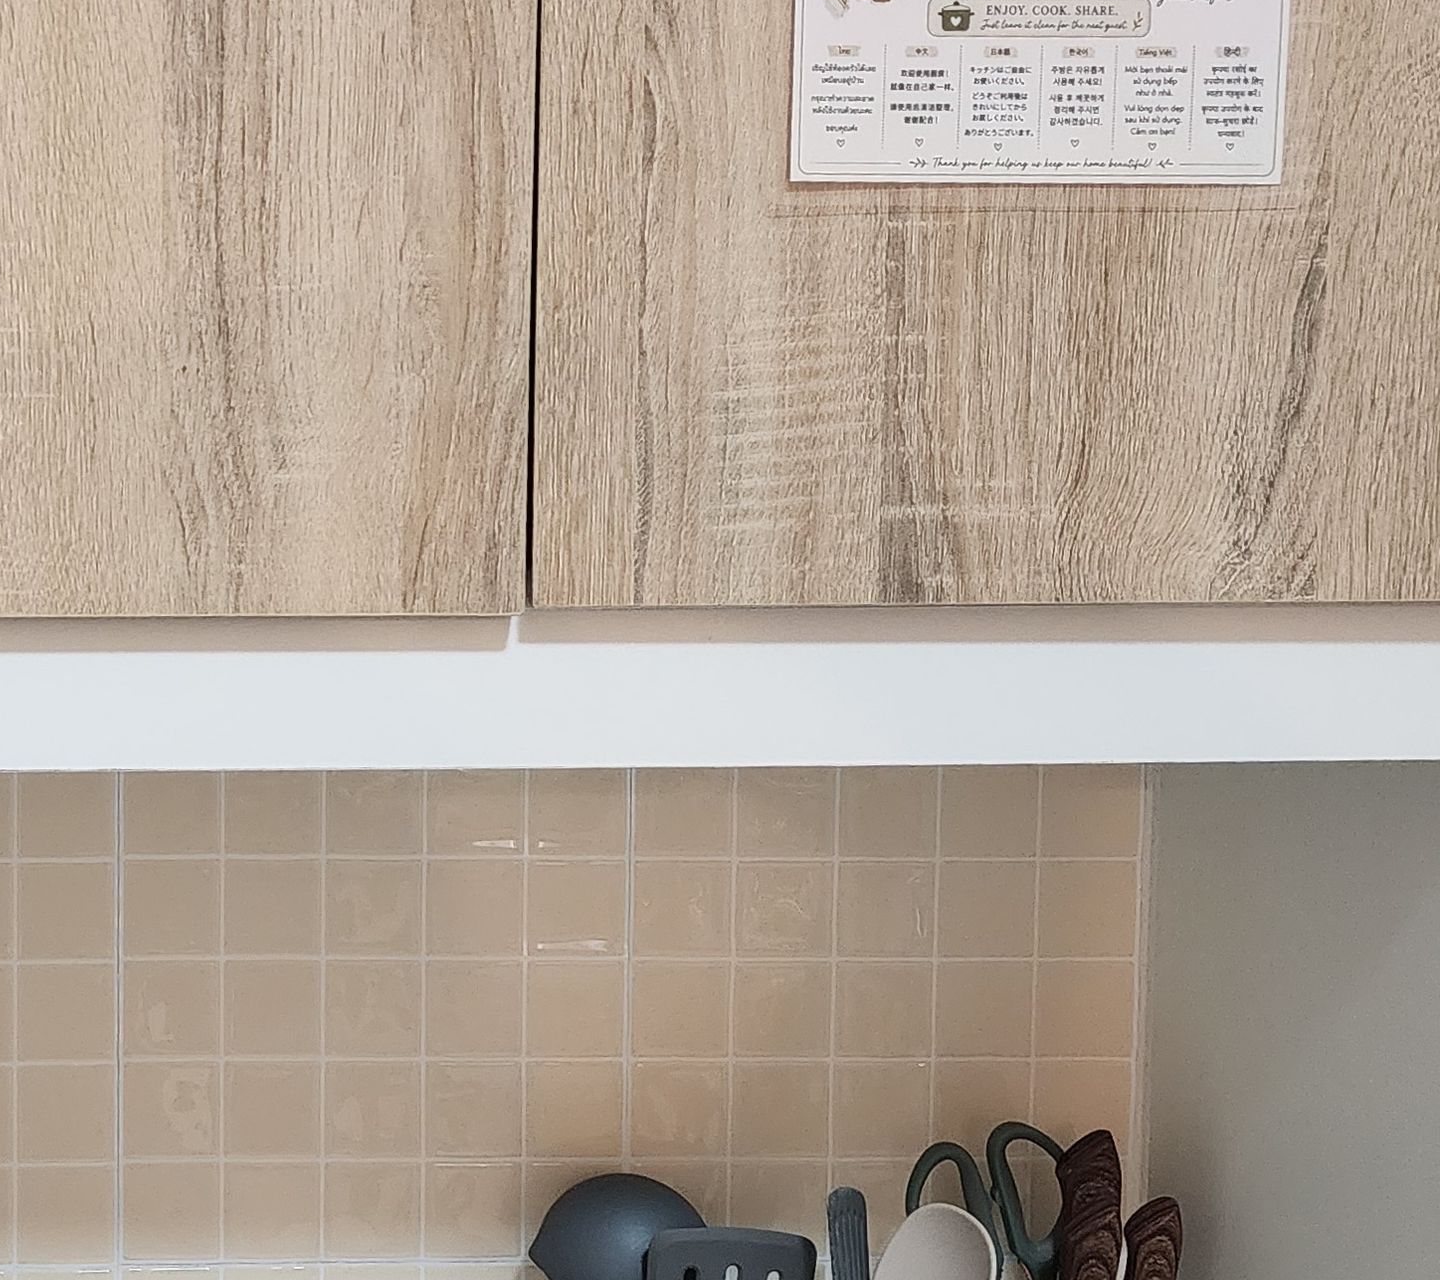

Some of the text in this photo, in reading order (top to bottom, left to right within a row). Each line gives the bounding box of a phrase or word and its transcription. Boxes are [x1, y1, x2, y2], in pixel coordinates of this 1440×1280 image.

[986, 5, 1118, 16] ENJOY. COOK. SHARE.
[980, 19, 1000, 31] Just
[1025, 19, 1032, 29] it
[1034, 20, 1056, 30] clean
[1057, 20, 1070, 32] for
[1072, 19, 1084, 30] the
[990, 48, 1011, 56] 日本語
[1069, 48, 1089, 56] 한국어
[932, 157, 959, 168] Thank
[962, 161, 978, 171] you
[980, 158, 993, 171] for
[996, 157, 1028, 171] helping
[1044, 158, 1064, 171] keep
[1083, 158, 1106, 168] home
